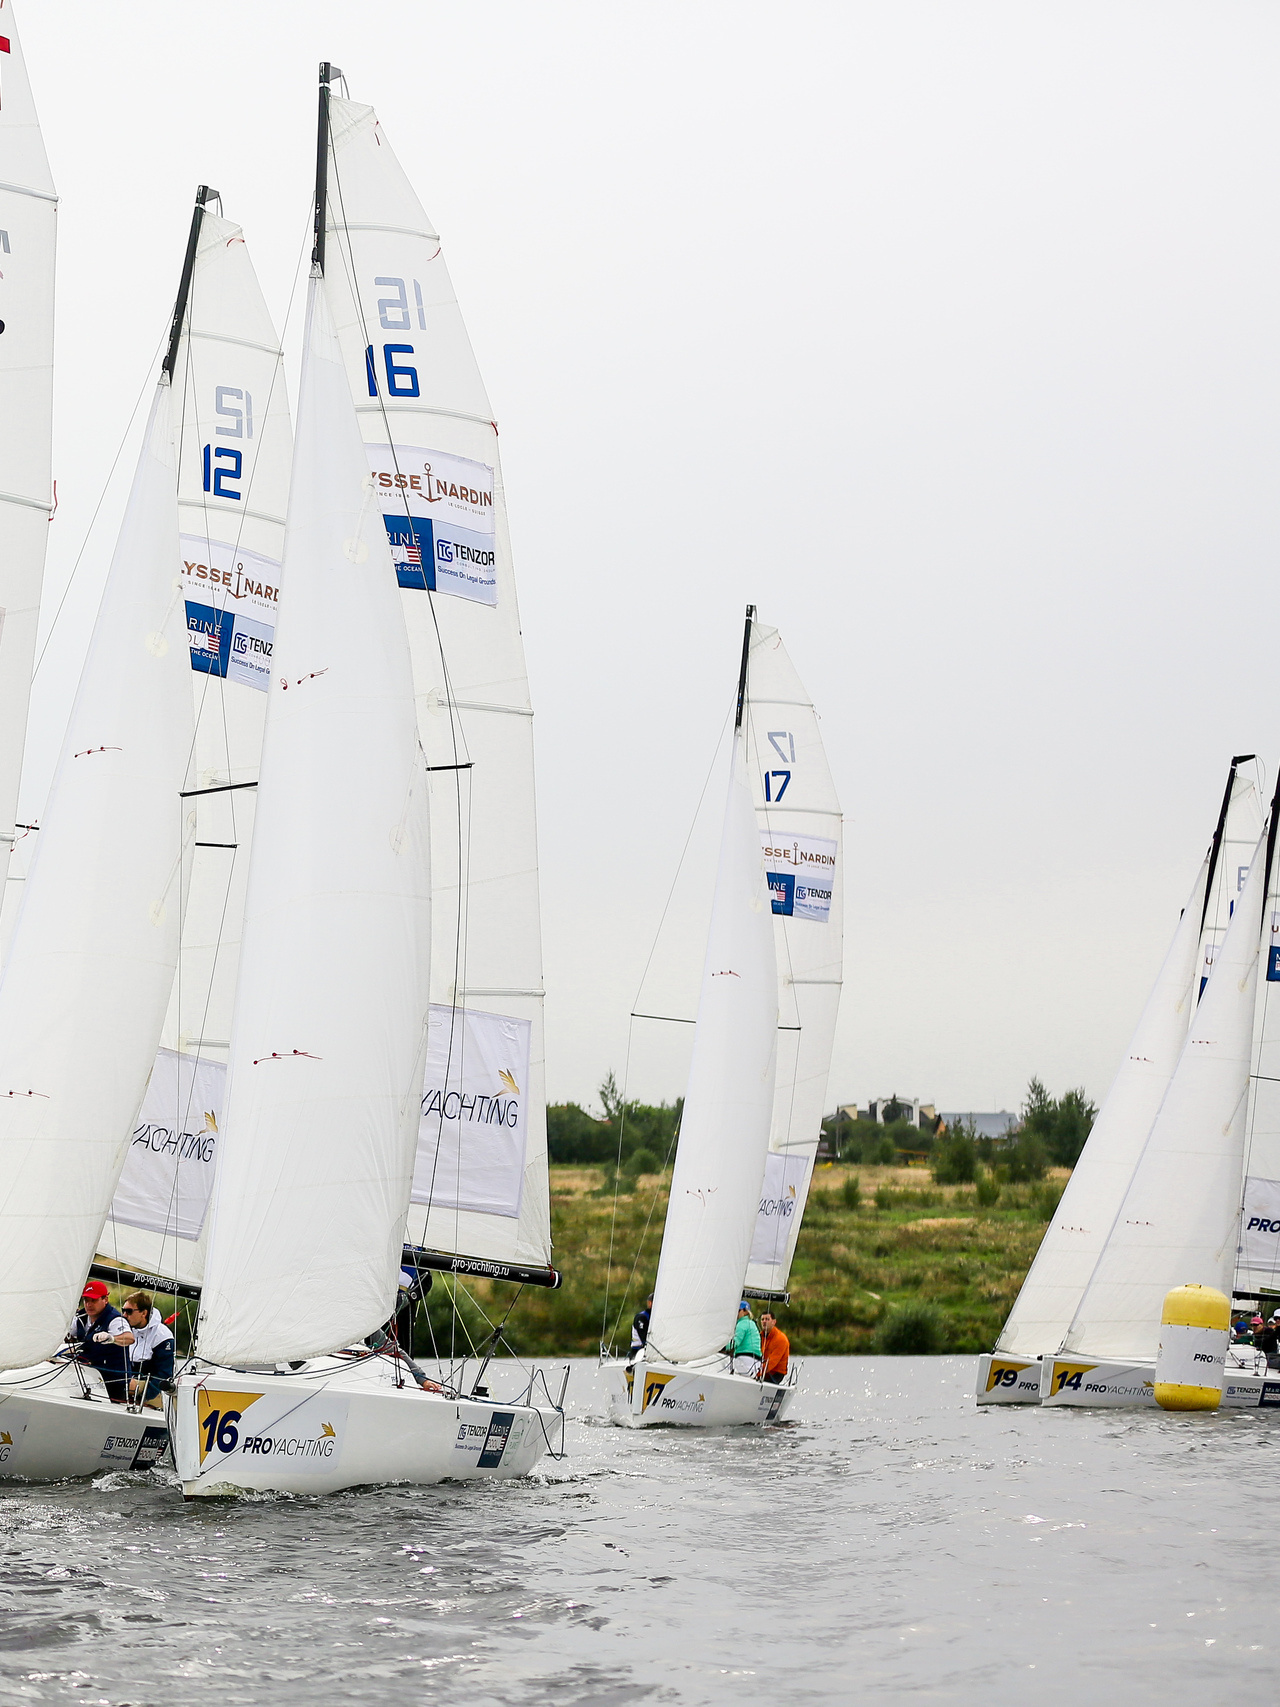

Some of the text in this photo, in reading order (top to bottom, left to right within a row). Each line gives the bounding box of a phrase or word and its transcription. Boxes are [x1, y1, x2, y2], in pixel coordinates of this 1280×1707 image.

[365, 343, 421, 398] 16
[203, 443, 242, 500] 12
[436, 478, 492, 507] NARDIN
[453, 543, 495, 566] TENZOR
[181, 560, 232, 586] YSSE
[466, 573, 478, 584] Legal
[188, 617, 222, 636] RINE
[191, 648, 218, 660] THE OCEAN
[249, 637, 274, 657] TENZ
[764, 770, 792, 803] 17
[761, 846, 836, 866] SSE NARDIN
[807, 888, 832, 900] TENZOR
[451, 1258, 510, 1277] pro-yachting.ru
[133, 1273, 180, 1292] pro-yachting.ru
[992, 1368, 1039, 1391] 19 PRO
[1056, 1371, 1154, 1397] 14 PROYACHTING
[646, 1382, 666, 1407] 17
[661, 1397, 704, 1413] PROYACHTING
[1236, 1386, 1261, 1394] TENZOR
[202, 1409, 335, 1457] 16 PROYACHTING
[467, 1425, 487, 1437] TENZOR
[115, 1437, 139, 1448] TENZOR
[142, 1436, 167, 1448] MARINE
